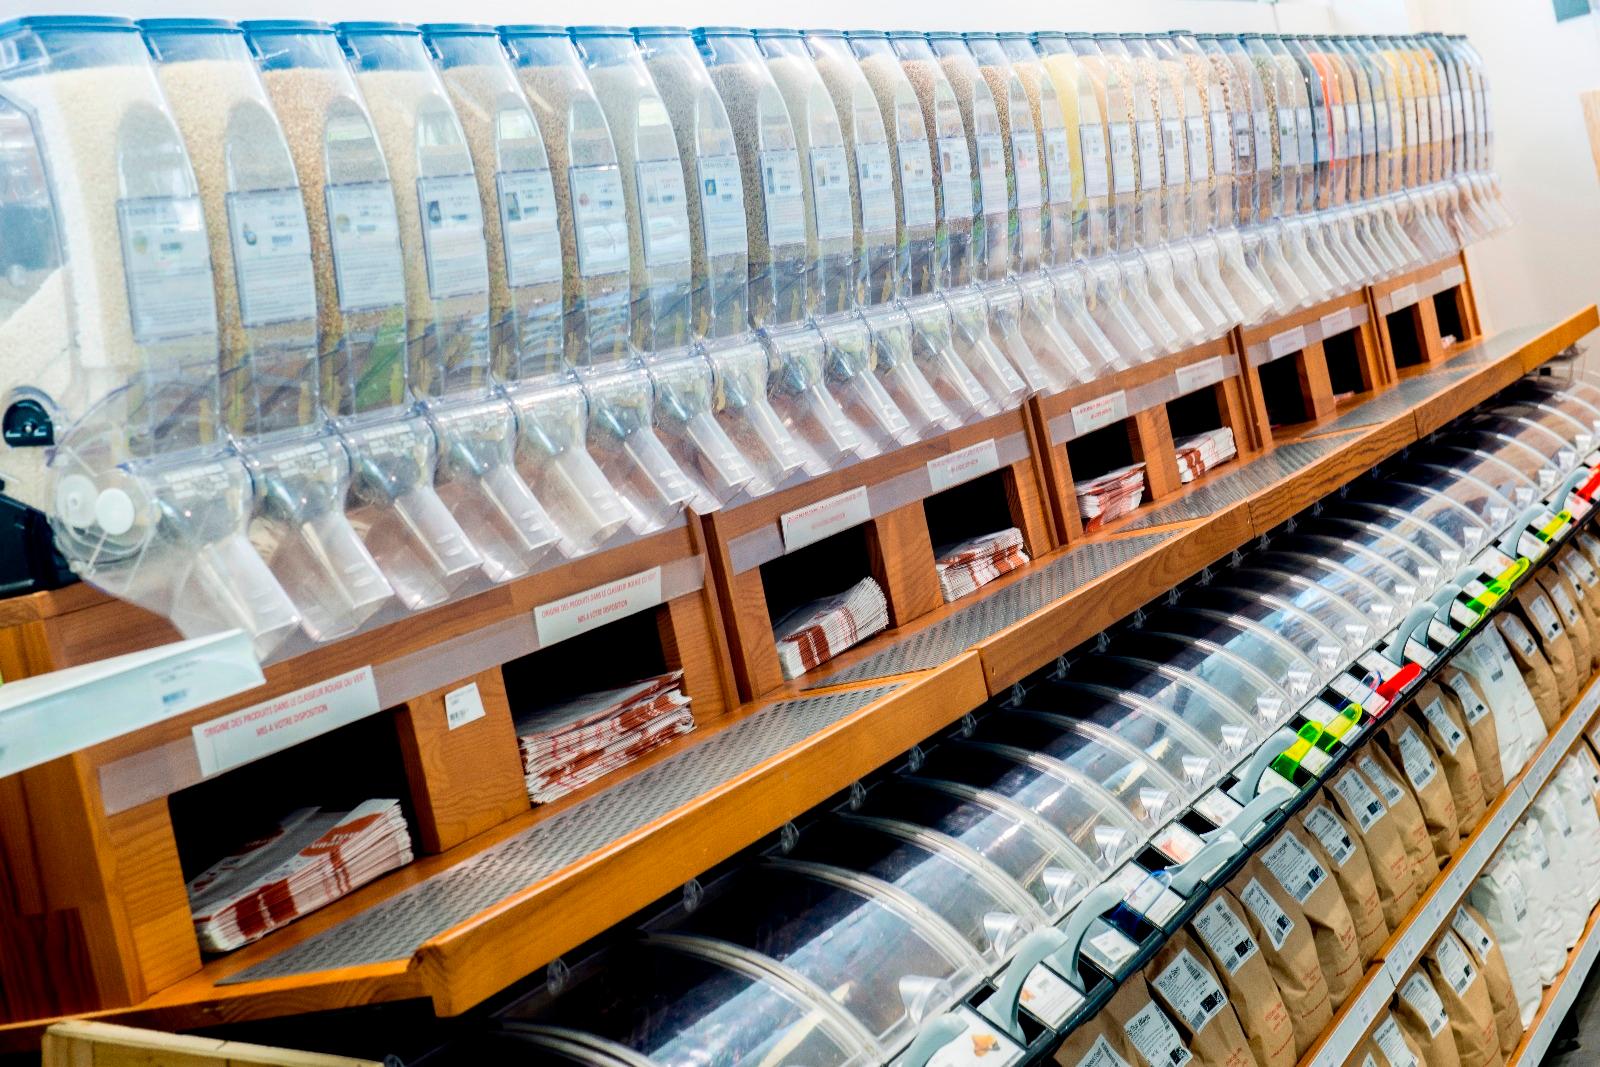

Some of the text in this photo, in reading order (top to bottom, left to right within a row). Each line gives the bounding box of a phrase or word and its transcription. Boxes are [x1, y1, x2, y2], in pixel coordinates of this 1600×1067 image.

[243, 707, 273, 726] PRODUITS
[272, 700, 290, 715] DANS
[290, 698, 298, 709] LE
[298, 686, 324, 704] CLASSEUR
[353, 671, 366, 685] VERT
[274, 716, 293, 731] VOTRE
[293, 703, 328, 723] DISPOSITION
